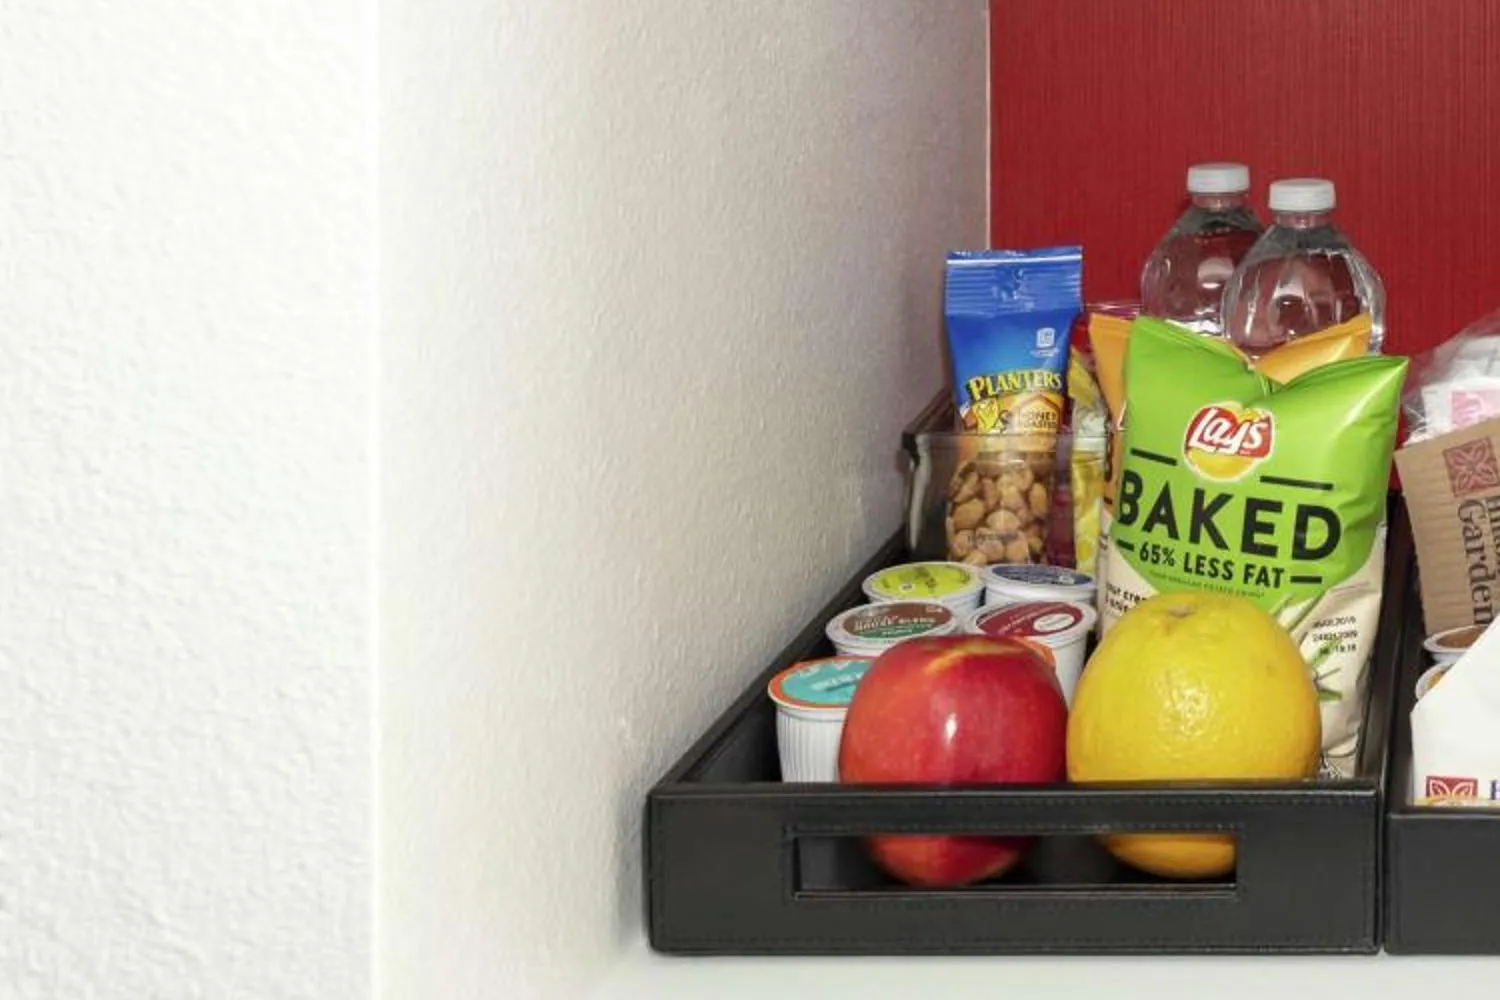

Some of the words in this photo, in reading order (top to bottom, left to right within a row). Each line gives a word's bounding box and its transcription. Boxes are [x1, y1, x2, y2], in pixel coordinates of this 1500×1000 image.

[968, 369, 1062, 401] PLANTERS
[1118, 469, 1342, 561] BAKED
[1139, 542, 1176, 567] 65%
[1183, 551, 1235, 581] LESS
[1243, 563, 1286, 589] FAT
[1458, 498, 1497, 626] Garden
